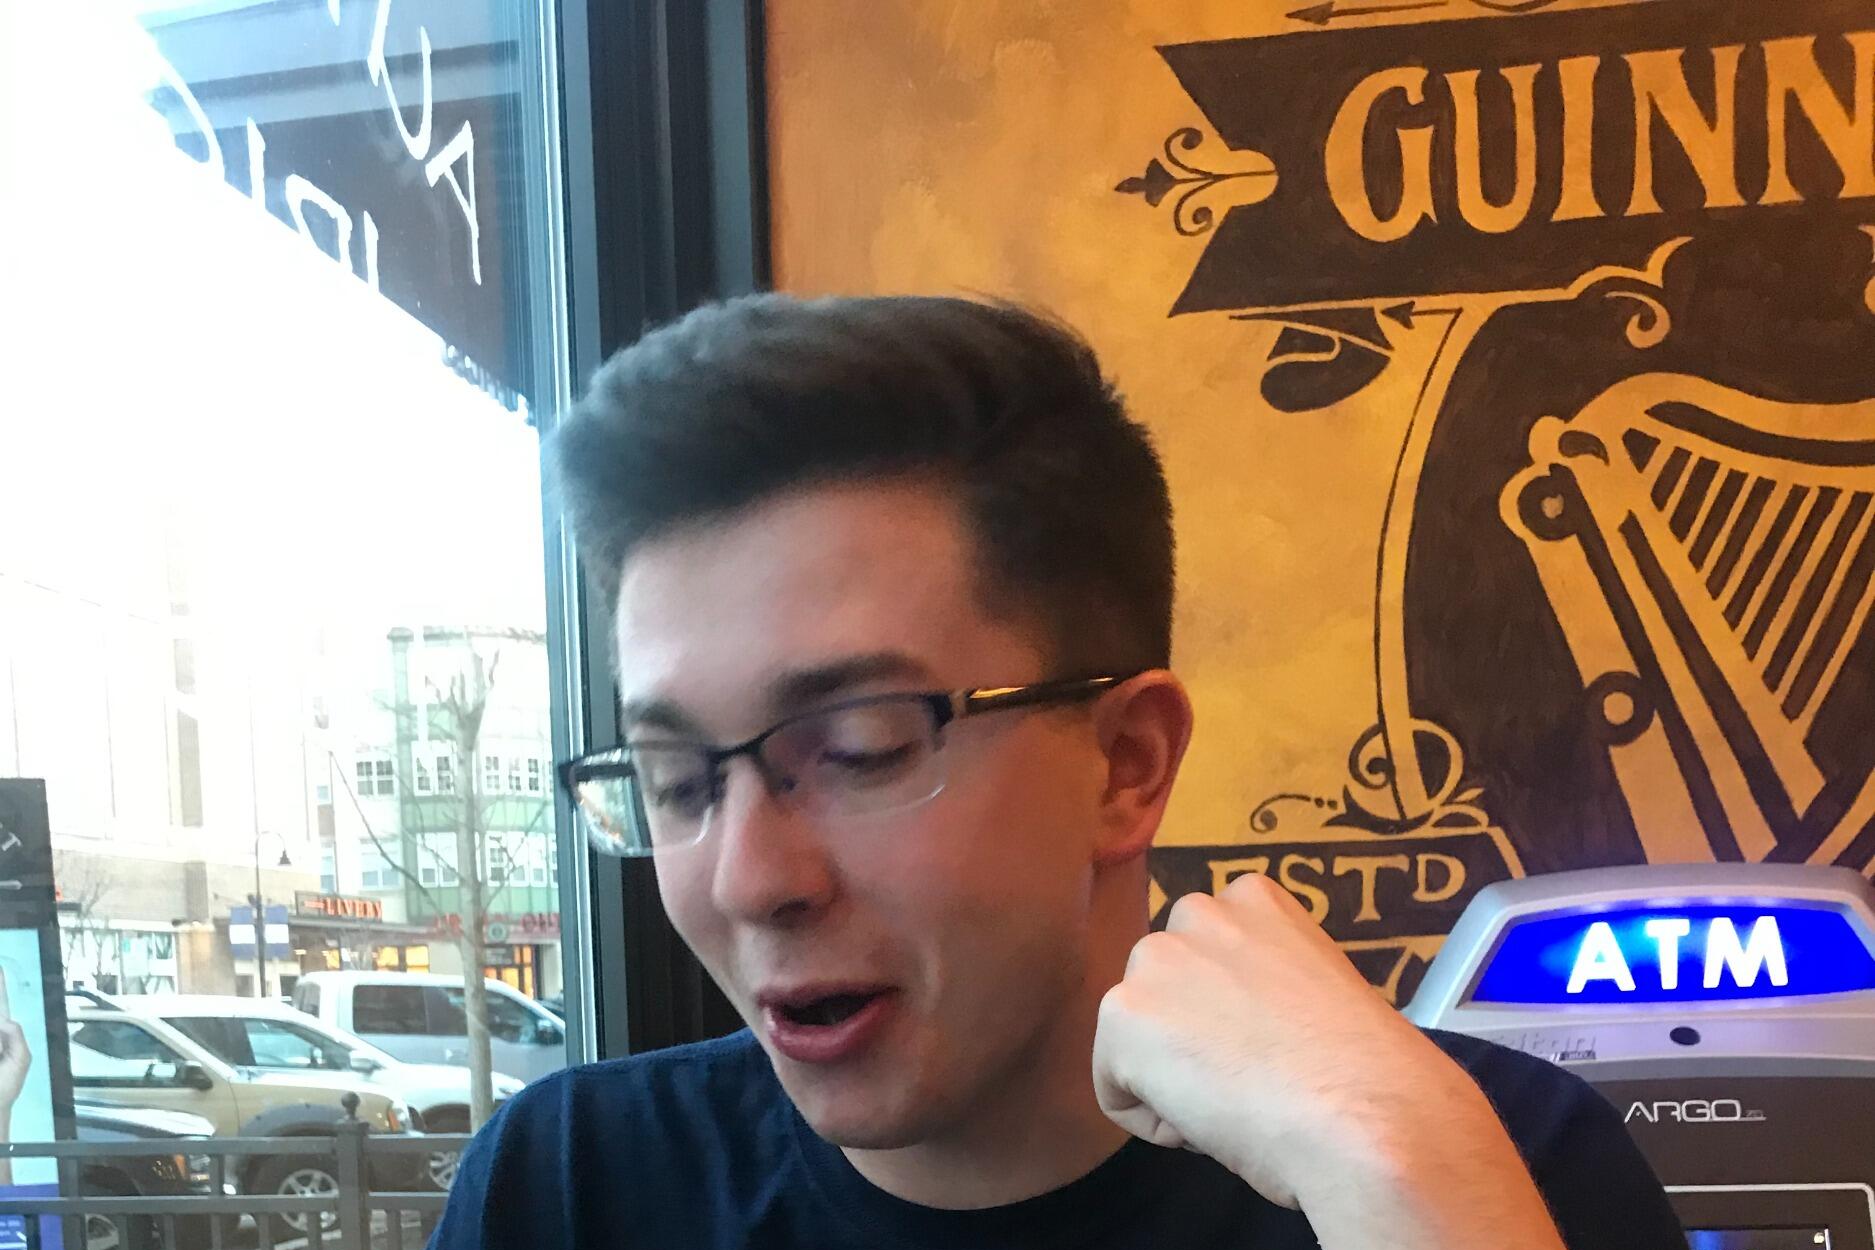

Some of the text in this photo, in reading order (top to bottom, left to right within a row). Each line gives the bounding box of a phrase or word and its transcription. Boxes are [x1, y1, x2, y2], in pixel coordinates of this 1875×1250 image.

[1325, 31, 1875, 243] GUINN
[1566, 915, 1789, 994] ATM
[1623, 1099, 1742, 1124] ARGO
